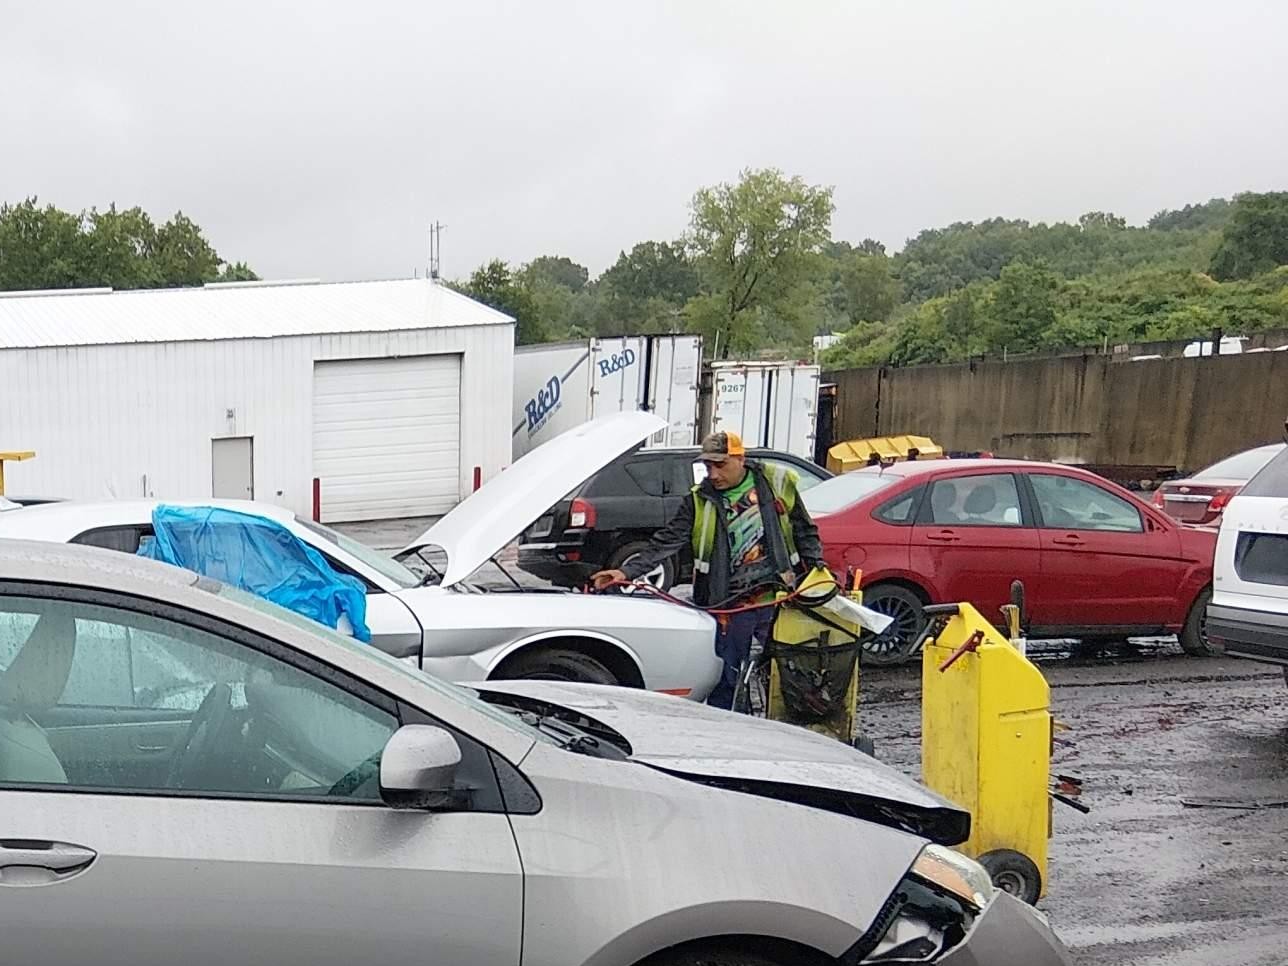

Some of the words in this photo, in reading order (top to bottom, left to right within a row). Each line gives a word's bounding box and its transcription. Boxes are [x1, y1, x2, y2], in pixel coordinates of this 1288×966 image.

[598, 348, 636, 378] R&D
[524, 375, 561, 432] R&D
[721, 384, 745, 393] 9267
